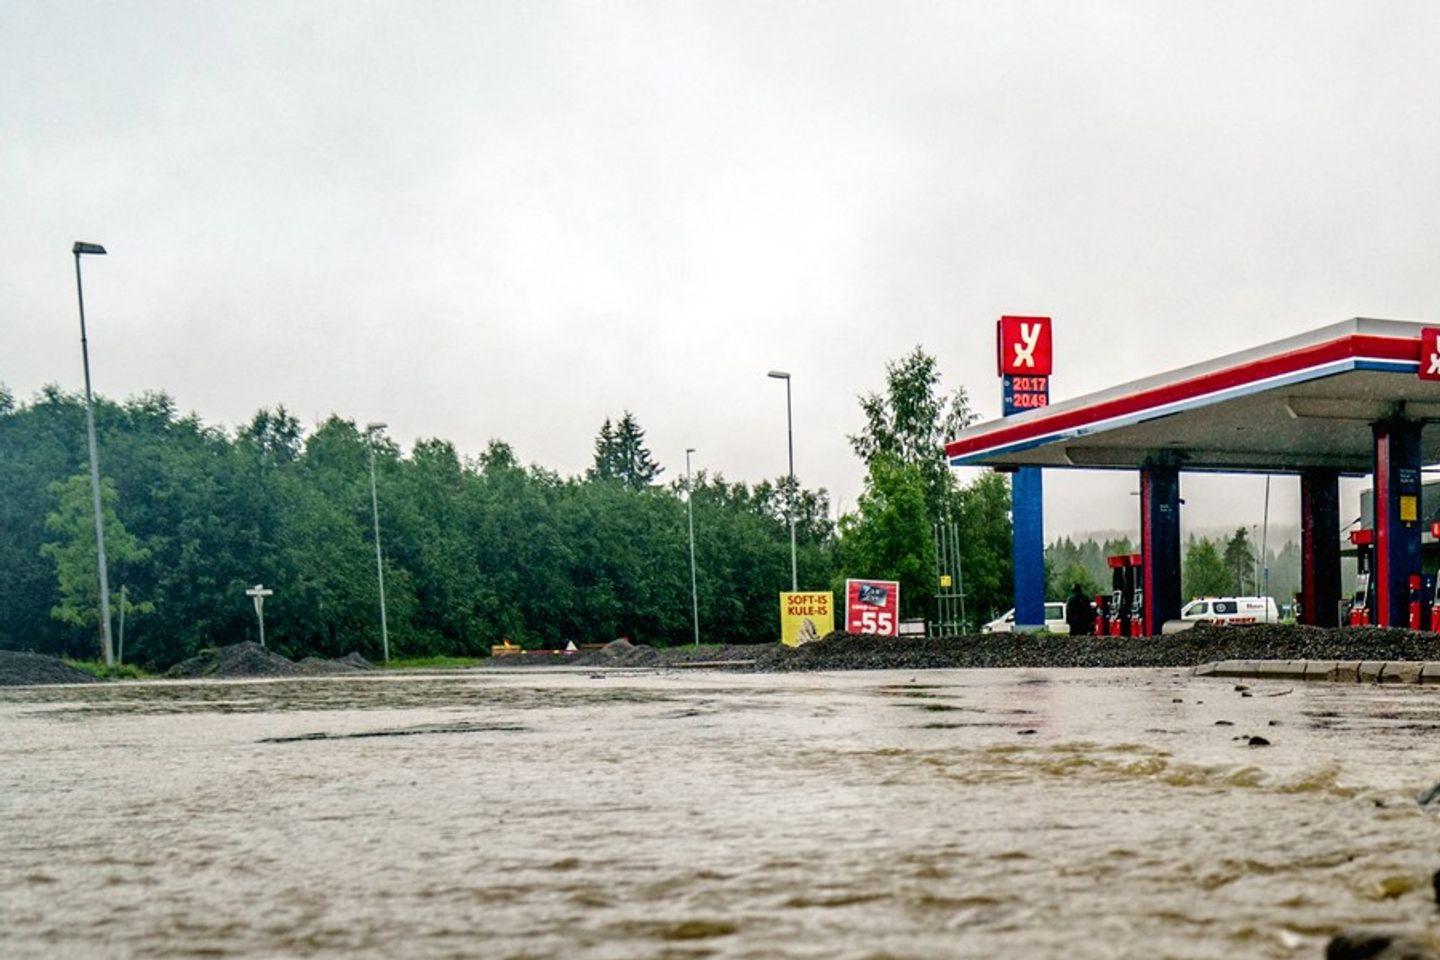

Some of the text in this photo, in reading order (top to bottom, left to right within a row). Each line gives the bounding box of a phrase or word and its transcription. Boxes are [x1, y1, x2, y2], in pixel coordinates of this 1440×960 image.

[787, 595, 828, 605] SOFT-IS
[787, 606, 828, 616] KULE-IS
[852, 611, 893, 635] -55
